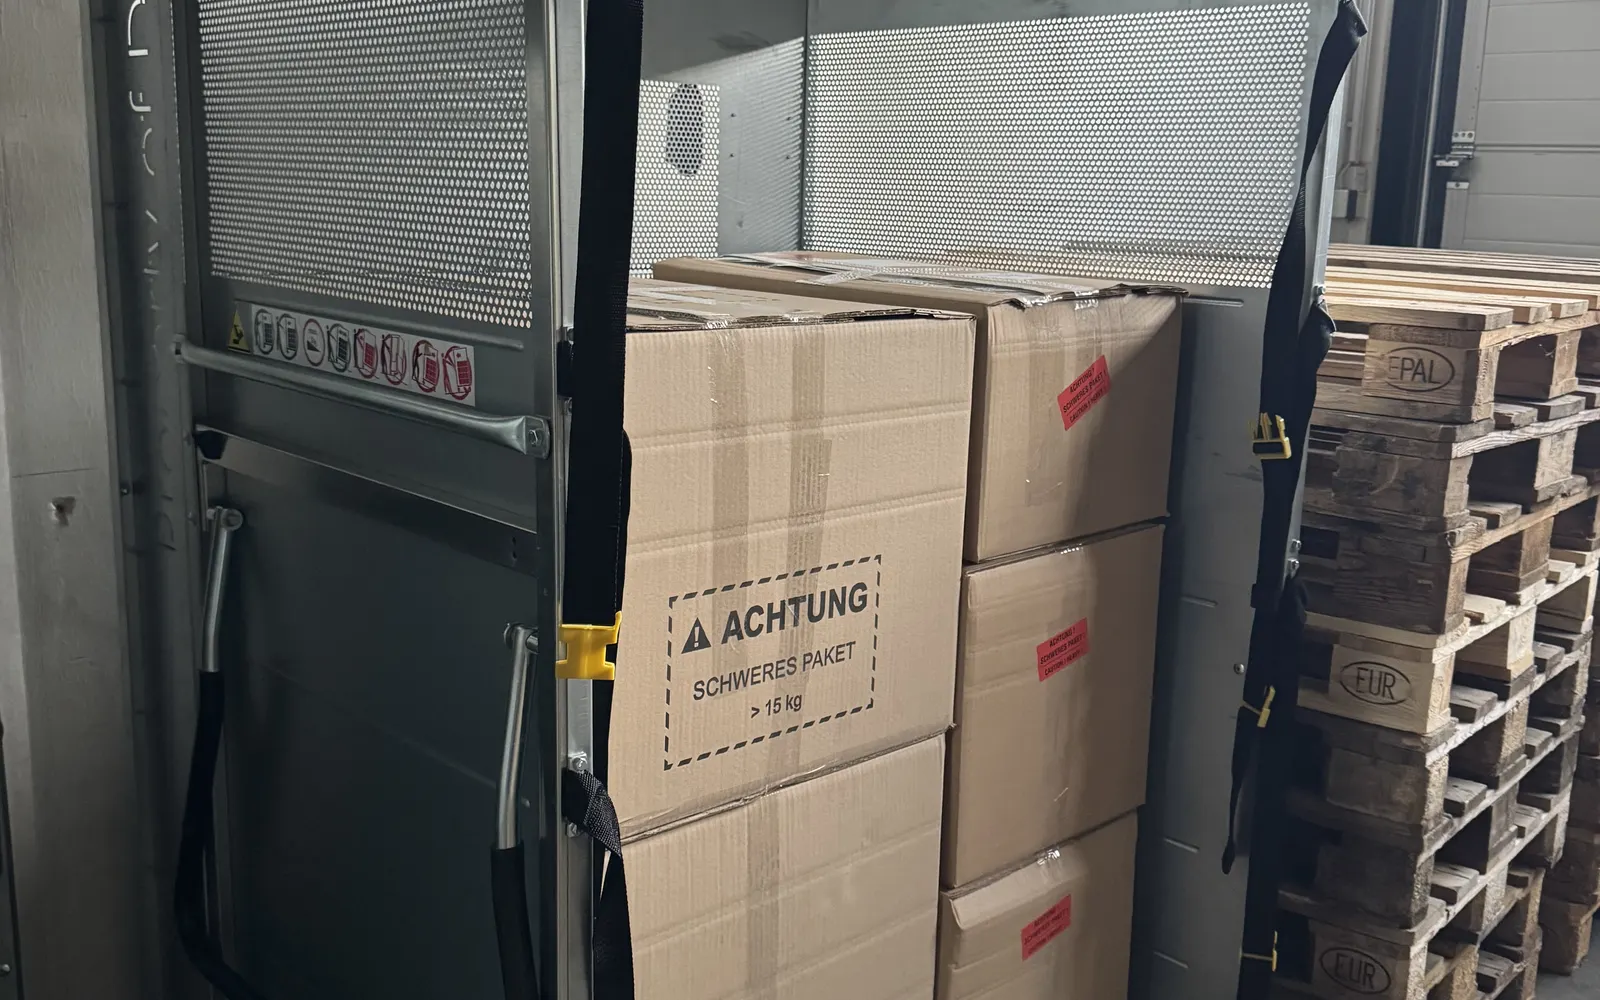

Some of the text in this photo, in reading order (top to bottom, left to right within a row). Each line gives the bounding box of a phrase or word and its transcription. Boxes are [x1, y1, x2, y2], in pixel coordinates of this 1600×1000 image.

[1388, 356, 1441, 384] EPAL
[1063, 386, 1089, 413] SCHWERES
[1089, 371, 1103, 391] PAKET
[721, 582, 868, 645] ACHTUNG
[693, 640, 856, 701] SCHWERES PAKET
[1356, 667, 1396, 700] EUR
[765, 696, 782, 717] 15
[785, 693, 802, 712] kg
[1334, 952, 1375, 990] EUR
